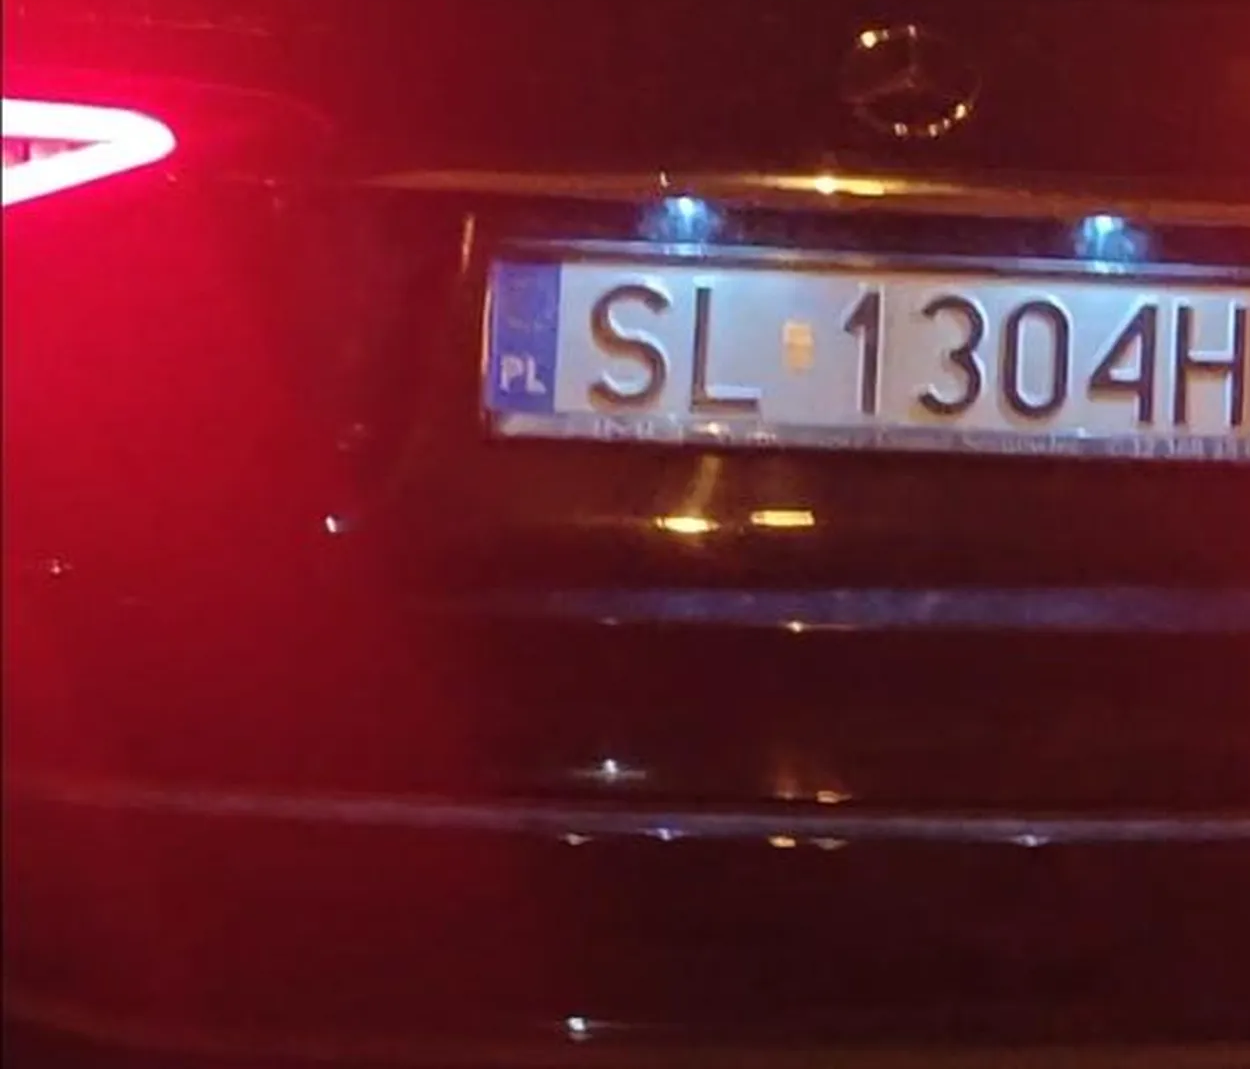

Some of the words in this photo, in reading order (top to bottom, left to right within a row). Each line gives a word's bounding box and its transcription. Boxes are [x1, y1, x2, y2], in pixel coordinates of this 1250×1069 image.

[500, 354, 547, 395] PL
[589, 281, 760, 413] SL
[843, 287, 1248, 426] 1304H
